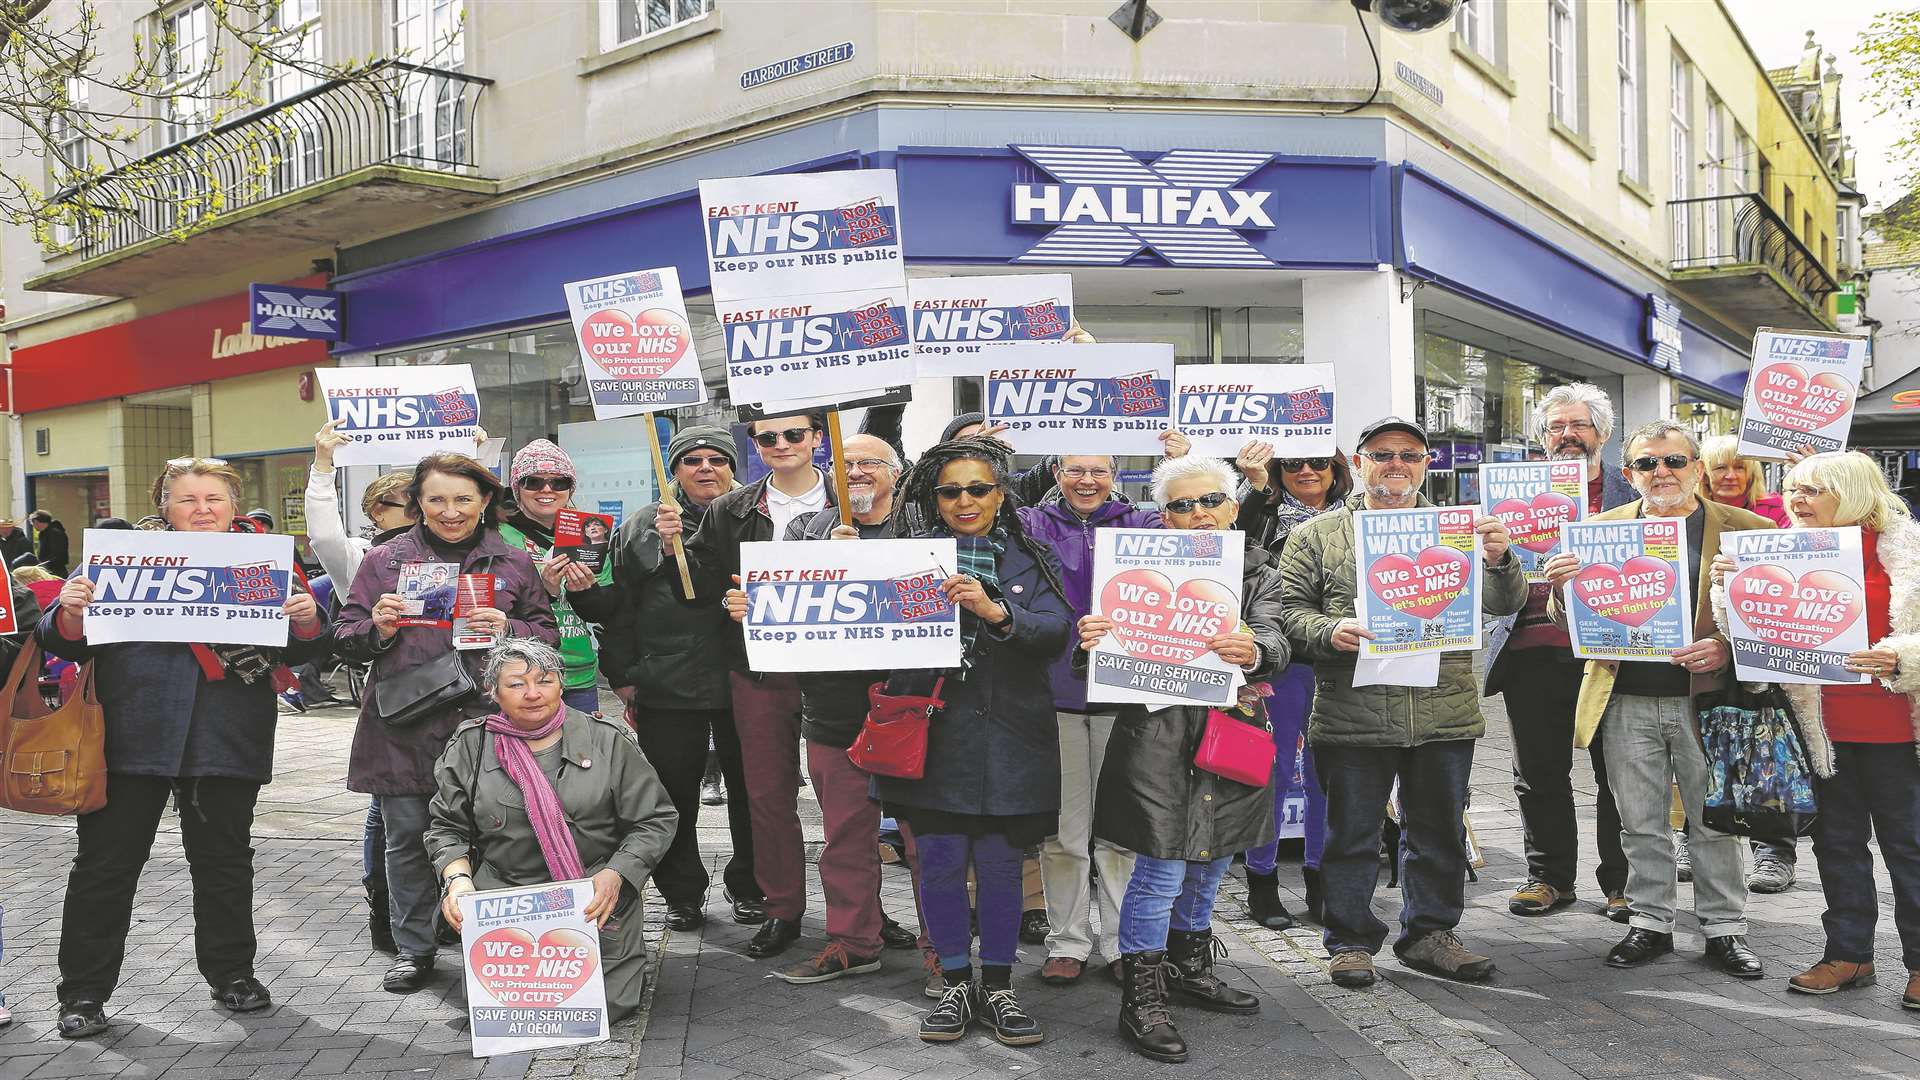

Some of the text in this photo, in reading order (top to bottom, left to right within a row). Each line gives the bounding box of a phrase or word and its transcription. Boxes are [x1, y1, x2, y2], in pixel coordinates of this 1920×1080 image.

[743, 44, 849, 86] HARBOUR STREET
[708, 202, 799, 217] EAST KENT
[842, 202, 876, 220] NOT
[1015, 186, 1276, 226] HALIFAX
[848, 214, 881, 232] FOR
[716, 214, 819, 255] NHS
[850, 226, 888, 246] SALE
[714, 249, 897, 273] Keep our NHS public
[582, 280, 626, 302] NHS
[257, 303, 336, 321] HALIFAX
[914, 299, 987, 309] EAST KENT
[723, 306, 812, 324] EAST KENT
[591, 323, 681, 337] We love
[916, 310, 1003, 340] NHS
[593, 337, 677, 354] our NHS
[731, 317, 833, 361] NHS
[731, 348, 910, 377] Keep our NHS public
[989, 369, 1076, 379] EAST KENT
[594, 381, 695, 391] SAVE OUR SERVICES
[1180, 385, 1213, 393] EAST
[622, 392, 667, 402] AT QEQM
[993, 381, 1094, 415] NHS
[336, 398, 420, 428] NHS
[1182, 394, 1268, 422] NHS
[1038, 420, 1066, 429] our
[1072, 419, 1107, 429] NHS
[1114, 419, 1168, 431] public
[1179, 427, 1214, 437] Keep
[1249, 426, 1279, 435] NHS
[1284, 427, 1332, 437] public
[1746, 421, 1837, 450] SAVE OUR SERVICES
[1489, 467, 1547, 482] THANET
[1489, 482, 1546, 499] WATCH
[1366, 515, 1434, 533] THANET
[1439, 513, 1470, 525] 60p
[1366, 534, 1433, 554] WATCH
[1572, 526, 1639, 544] THANET
[1739, 535, 1795, 553] NHS
[1117, 536, 1178, 556] NHS
[90, 555, 188, 566] EAST KENT
[1115, 558, 1140, 566] Keep
[233, 565, 270, 578] NOT
[747, 569, 848, 581] EAST KENT
[1375, 560, 1461, 585] We love
[94, 569, 207, 601] NHS
[239, 577, 273, 589] FOR
[895, 574, 935, 593] NOT
[1382, 572, 1461, 599] our NHS
[1581, 570, 1666, 593] We love
[1744, 577, 1852, 604] We love
[237, 588, 279, 602] SALE
[752, 583, 869, 623] NHS
[901, 588, 940, 605] FOR
[1117, 583, 1228, 618] We love
[1391, 599, 1416, 611] let's
[1418, 594, 1442, 608] fight
[1445, 591, 1460, 601] for
[1588, 582, 1665, 607] our NHS
[89, 606, 283, 620] Keep our NHS public
[901, 602, 945, 620] SALE
[1741, 600, 1846, 622] our NHS
[1112, 608, 1222, 637] our NHS
[750, 625, 954, 643] Keep our NHS public
[1118, 627, 1206, 648] No Privatisation
[1125, 640, 1195, 660] NO CUTS
[1376, 637, 1472, 652] FEBRUARY EVENTS LISTINGS
[1737, 641, 1766, 655] SAVE
[1769, 647, 1793, 659] OUR
[1098, 655, 1226, 686] SAVE OUR SERVICES
[1767, 658, 1820, 675] AT QEQM
[1130, 675, 1188, 694] AT QEQM
[478, 895, 533, 919] NHS
[483, 942, 589, 958] We love
[482, 960, 583, 978] our NHS
[490, 981, 573, 989] No Privatisation
[497, 992, 564, 1002] NO CUTS
[476, 1010, 597, 1021] SAVE OUR SERVICES
[508, 1023, 562, 1034] AT QEQM
